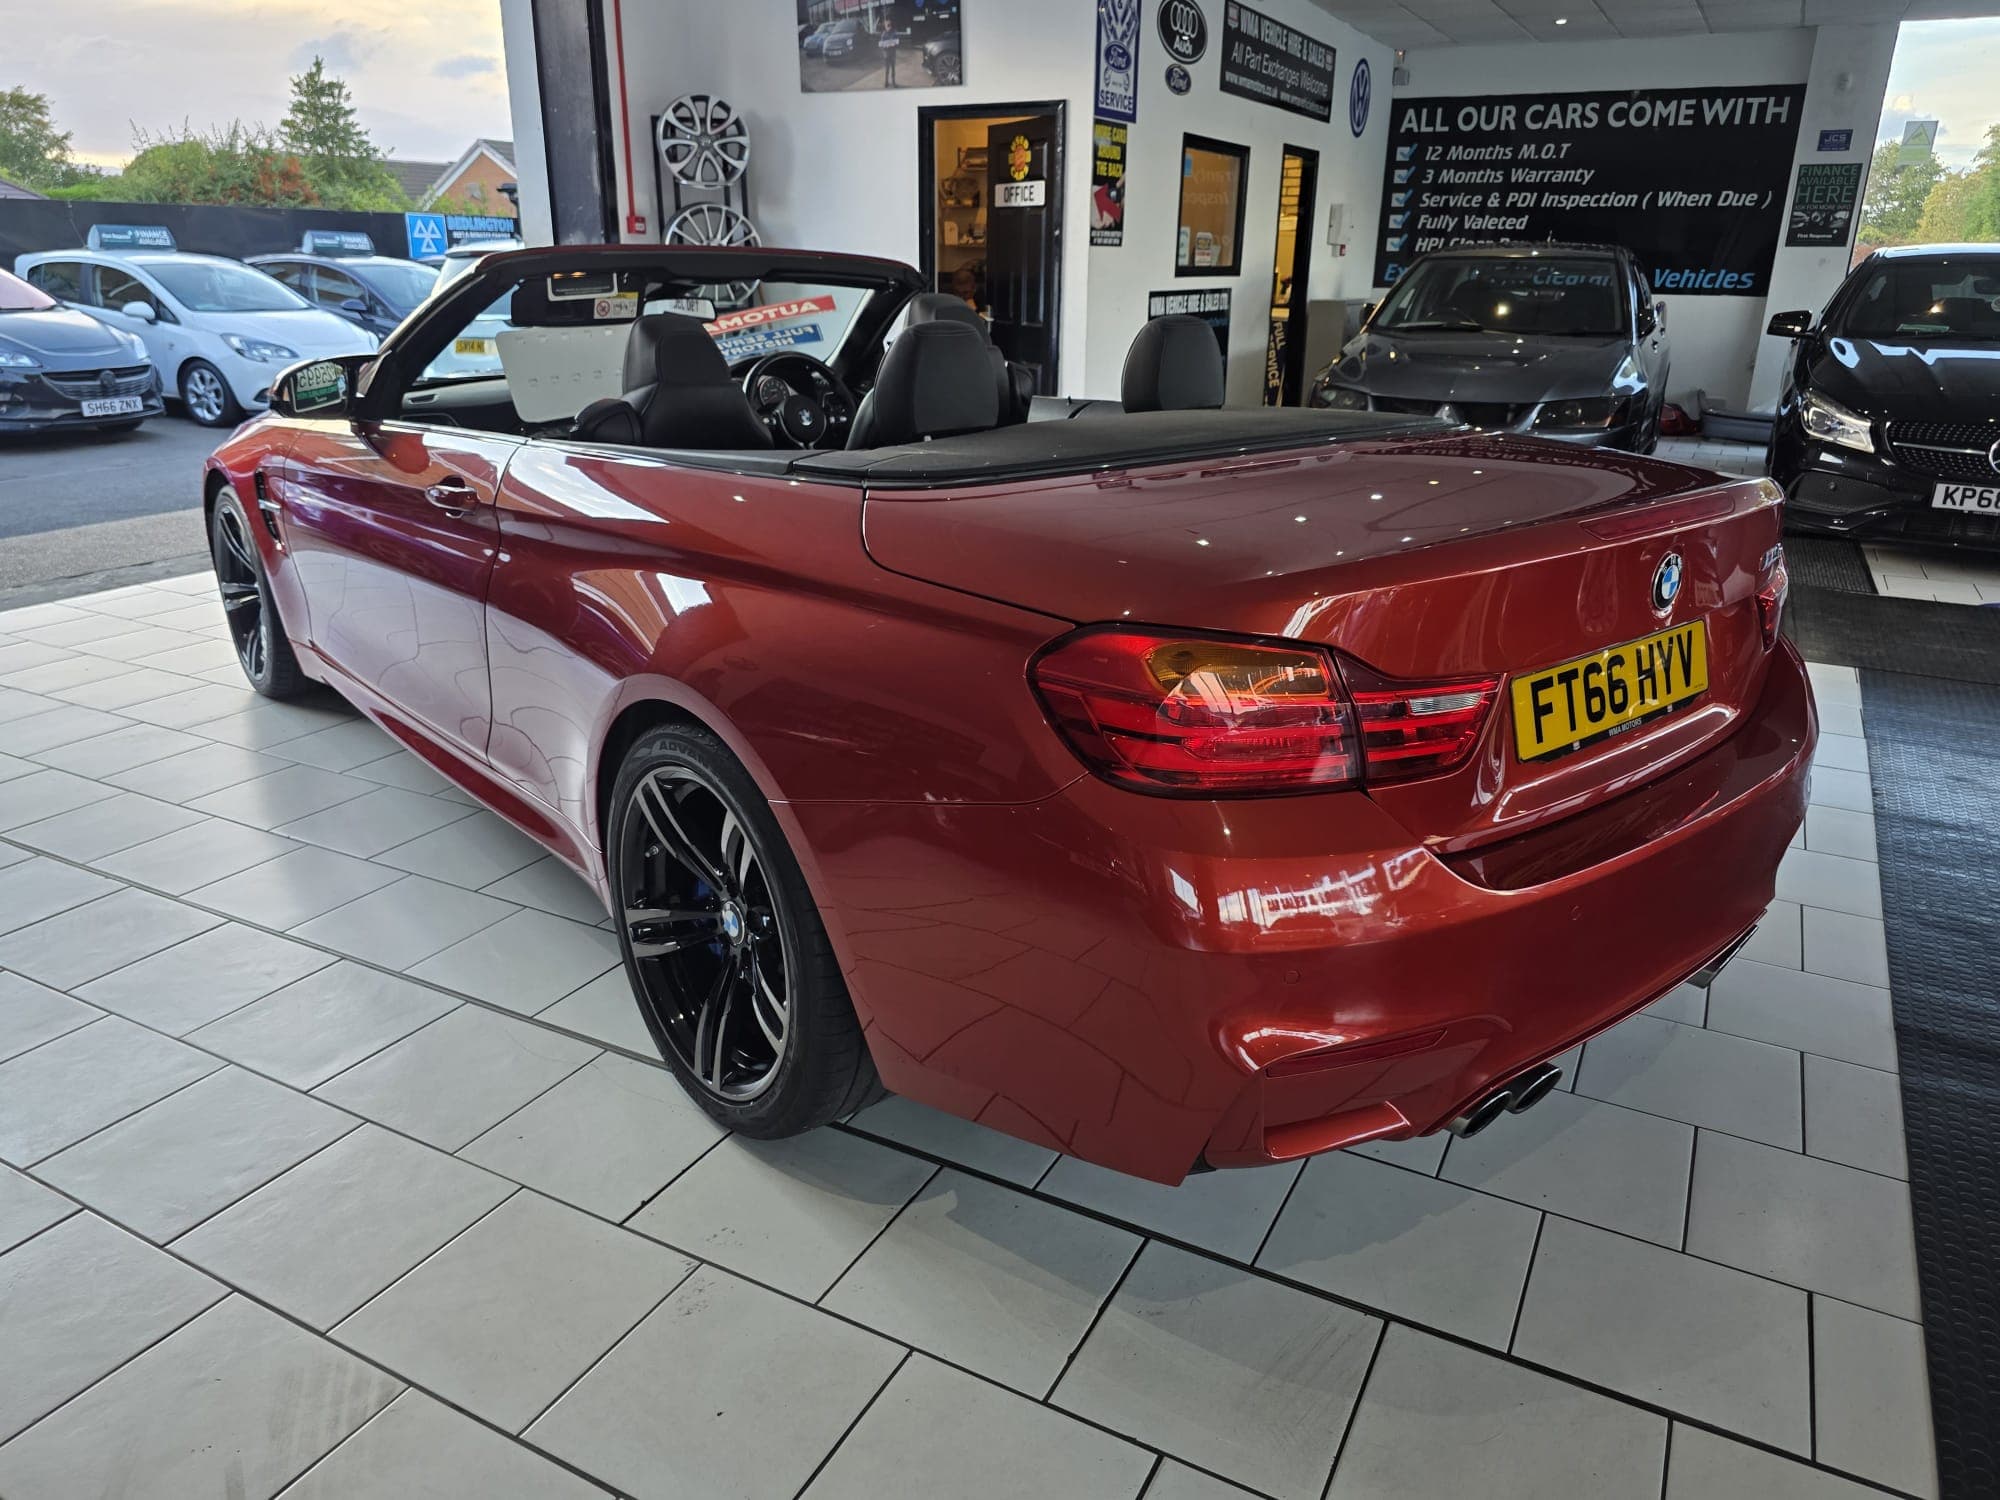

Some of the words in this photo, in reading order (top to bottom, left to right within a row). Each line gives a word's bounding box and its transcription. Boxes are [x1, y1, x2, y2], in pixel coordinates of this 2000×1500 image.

[1173, 35, 1192, 56] Audi
[1240, 8, 1259, 39] WMA
[1260, 18, 1288, 51] VEHICLE
[1287, 31, 1302, 57] HIRE
[1302, 39, 1308, 60] &
[1308, 42, 1325, 68] SALES
[1231, 41, 1244, 64] All
[1244, 46, 1262, 71] Part
[1262, 53, 1299, 88] Exchanges
[1300, 70, 1328, 98] Welcome
[1100, 89, 1133, 111] SERVICE
[1400, 107, 1449, 133] ALL
[1457, 105, 1516, 132] OUR
[1524, 102, 1600, 130] CARS
[1607, 98, 1696, 128] COME
[1701, 96, 1790, 126] WITH
[1112, 127, 1127, 144] CARS
[1823, 134, 1847, 143] JCS
[1425, 146, 1441, 161] 12
[1447, 145, 1512, 161] Months
[1518, 143, 1571, 160] M.O.T
[1096, 161, 1107, 176] THE
[1108, 162, 1123, 177] BACK
[1421, 169, 1434, 184] 3
[1438, 168, 1504, 184] Months
[1511, 168, 1595, 185] Warranty
[1799, 165, 1858, 176] FINANCE
[1799, 177, 1857, 185] AVAILABLE
[1004, 185, 1034, 203] OFFICE
[1419, 192, 1483, 208] Service
[1487, 193, 1500, 208] &
[1506, 192, 1537, 207] PDI
[1541, 191, 1638, 210] Inspection
[1657, 190, 1713, 207] When
[1717, 190, 1758, 207] Due
[1795, 186, 1856, 203] HERE
[447, 215, 514, 232] BEDLINGTON
[1417, 214, 1458, 232] Fully
[1464, 215, 1529, 230] Valeted
[1415, 237, 1444, 252] HPI
[1654, 269, 1755, 289] Vehicles
[1166, 295, 1187, 314] VEHICLE
[1273, 321, 1286, 350] FULL
[1267, 334, 1281, 388] ERVICE
[88, 401, 117, 413] SH66
[119, 399, 140, 411] ZNX
[1530, 654, 1629, 744] FT66
[1636, 630, 1693, 705] HYV
[1608, 724, 1621, 737] WMA
[1622, 718, 1642, 732] MOTORS
